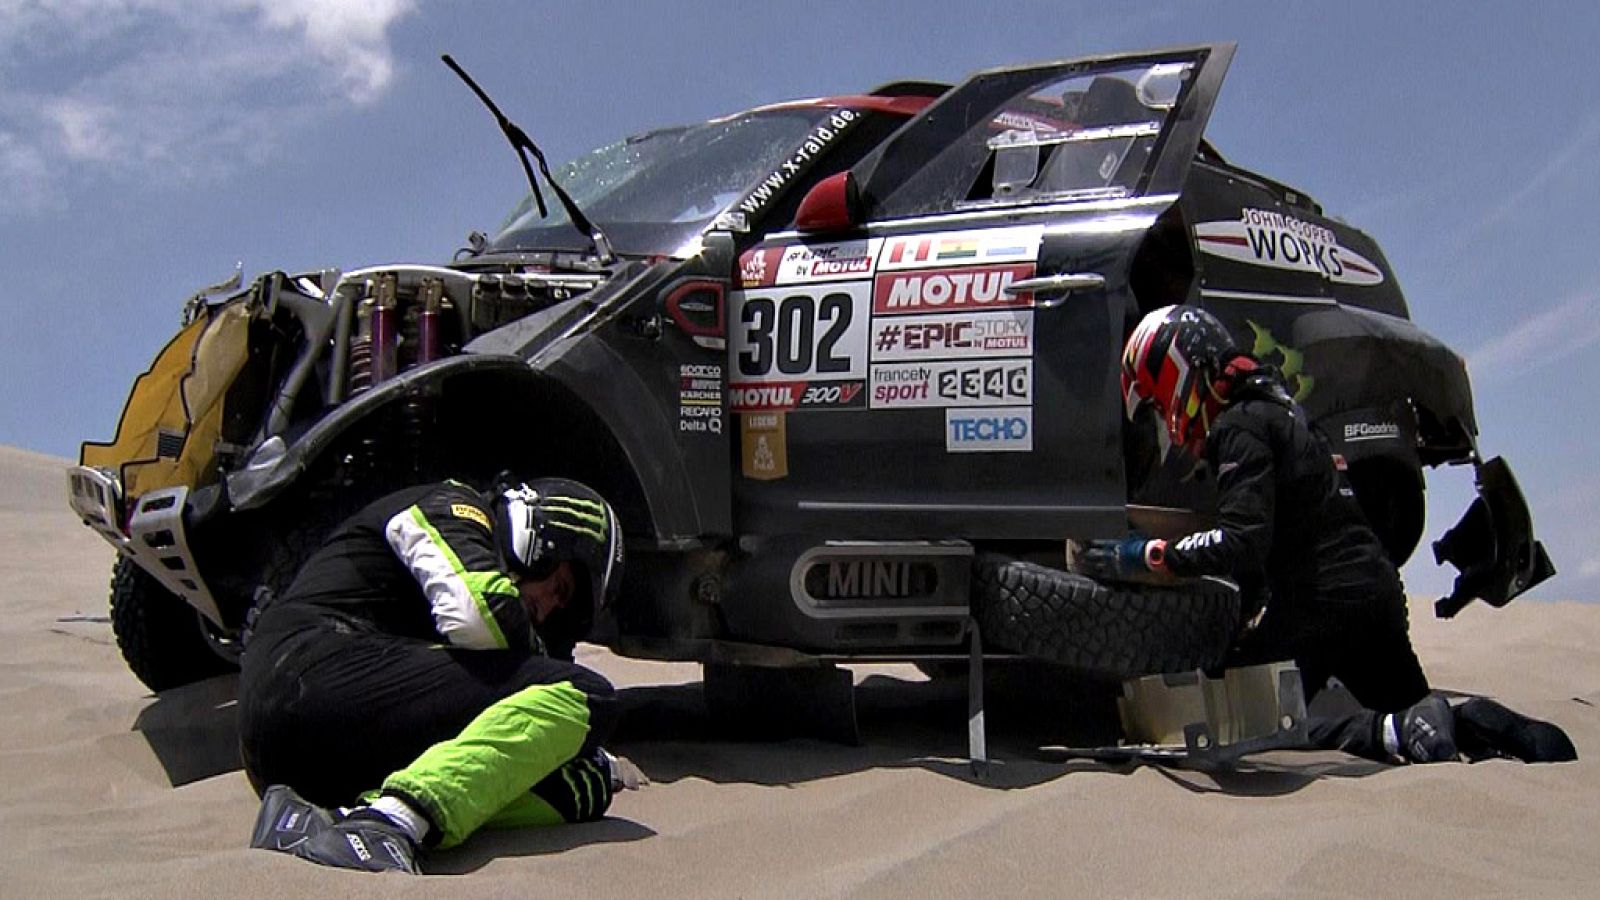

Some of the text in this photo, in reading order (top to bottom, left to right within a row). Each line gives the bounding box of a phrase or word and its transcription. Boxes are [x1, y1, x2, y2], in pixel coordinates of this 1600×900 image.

[1247, 227, 1343, 276] WORKS
[814, 260, 869, 276] MOTUL
[887, 271, 1017, 307] MOTUL
[739, 292, 853, 376] 302
[729, 383, 863, 406] MOTUL 300V
[874, 381, 930, 403] sport
[680, 419, 707, 431] Delta
[950, 417, 1028, 441] TECHO
[828, 560, 911, 597] MINI
